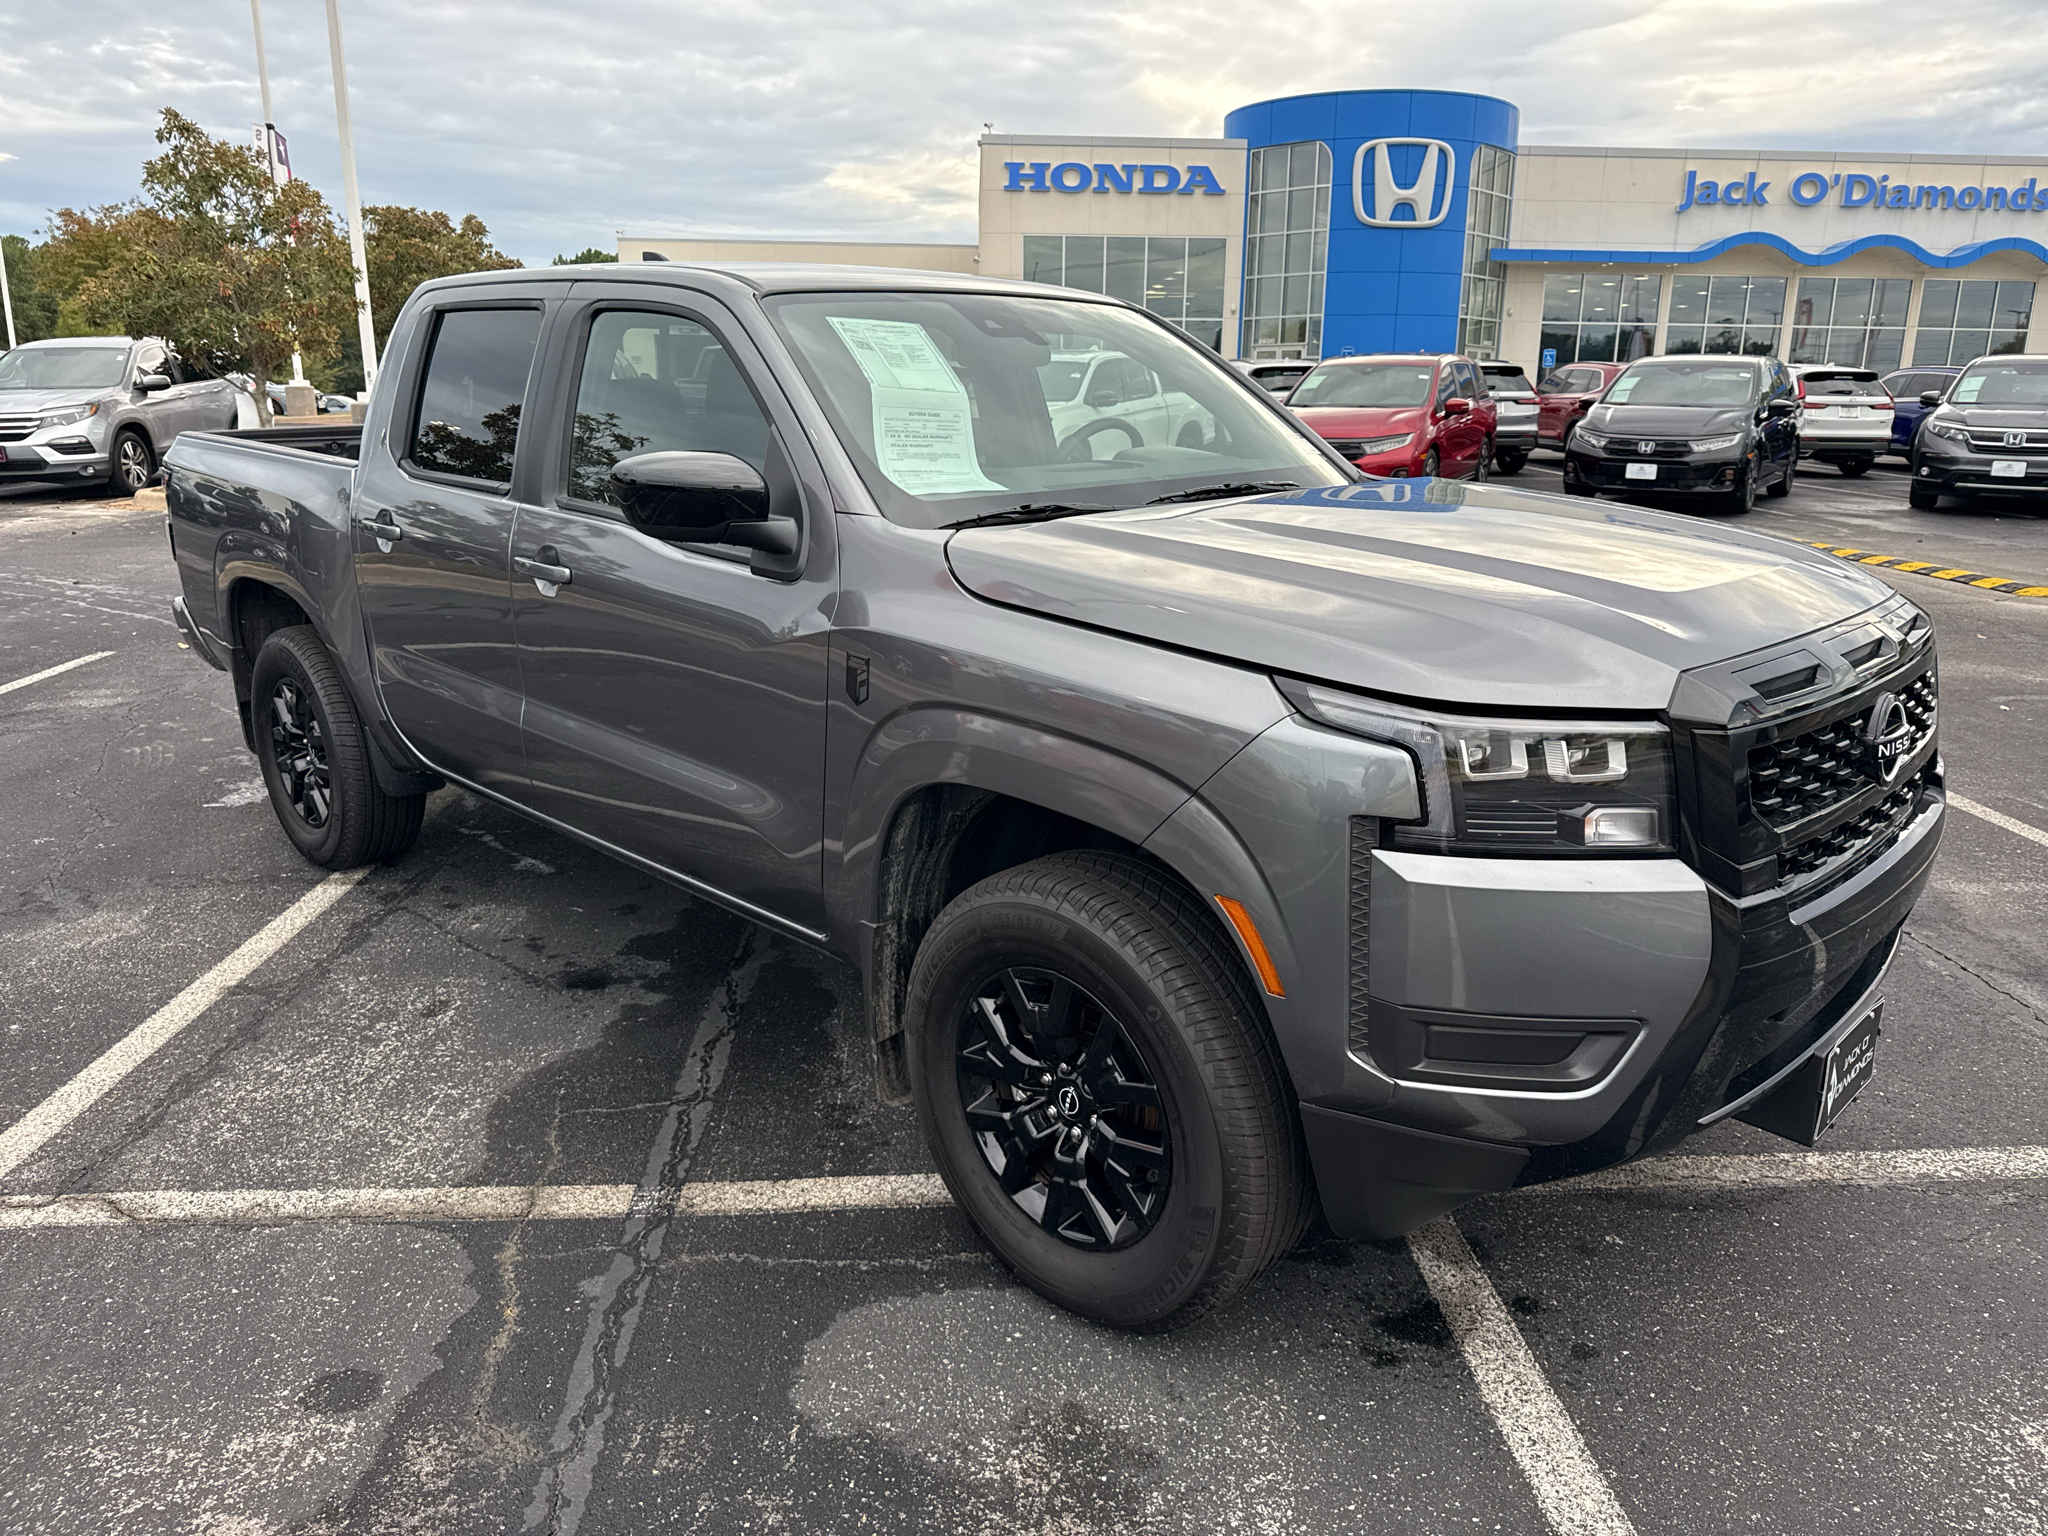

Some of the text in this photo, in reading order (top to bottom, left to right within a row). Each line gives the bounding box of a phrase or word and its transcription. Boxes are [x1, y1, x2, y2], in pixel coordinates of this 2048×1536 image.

[1003, 162, 1226, 195] HONDA
[1676, 169, 2048, 213] Jack O'Diamonds
[1878, 735, 1909, 758] NISS
[990, 913, 1061, 935] 265/65 R 17
